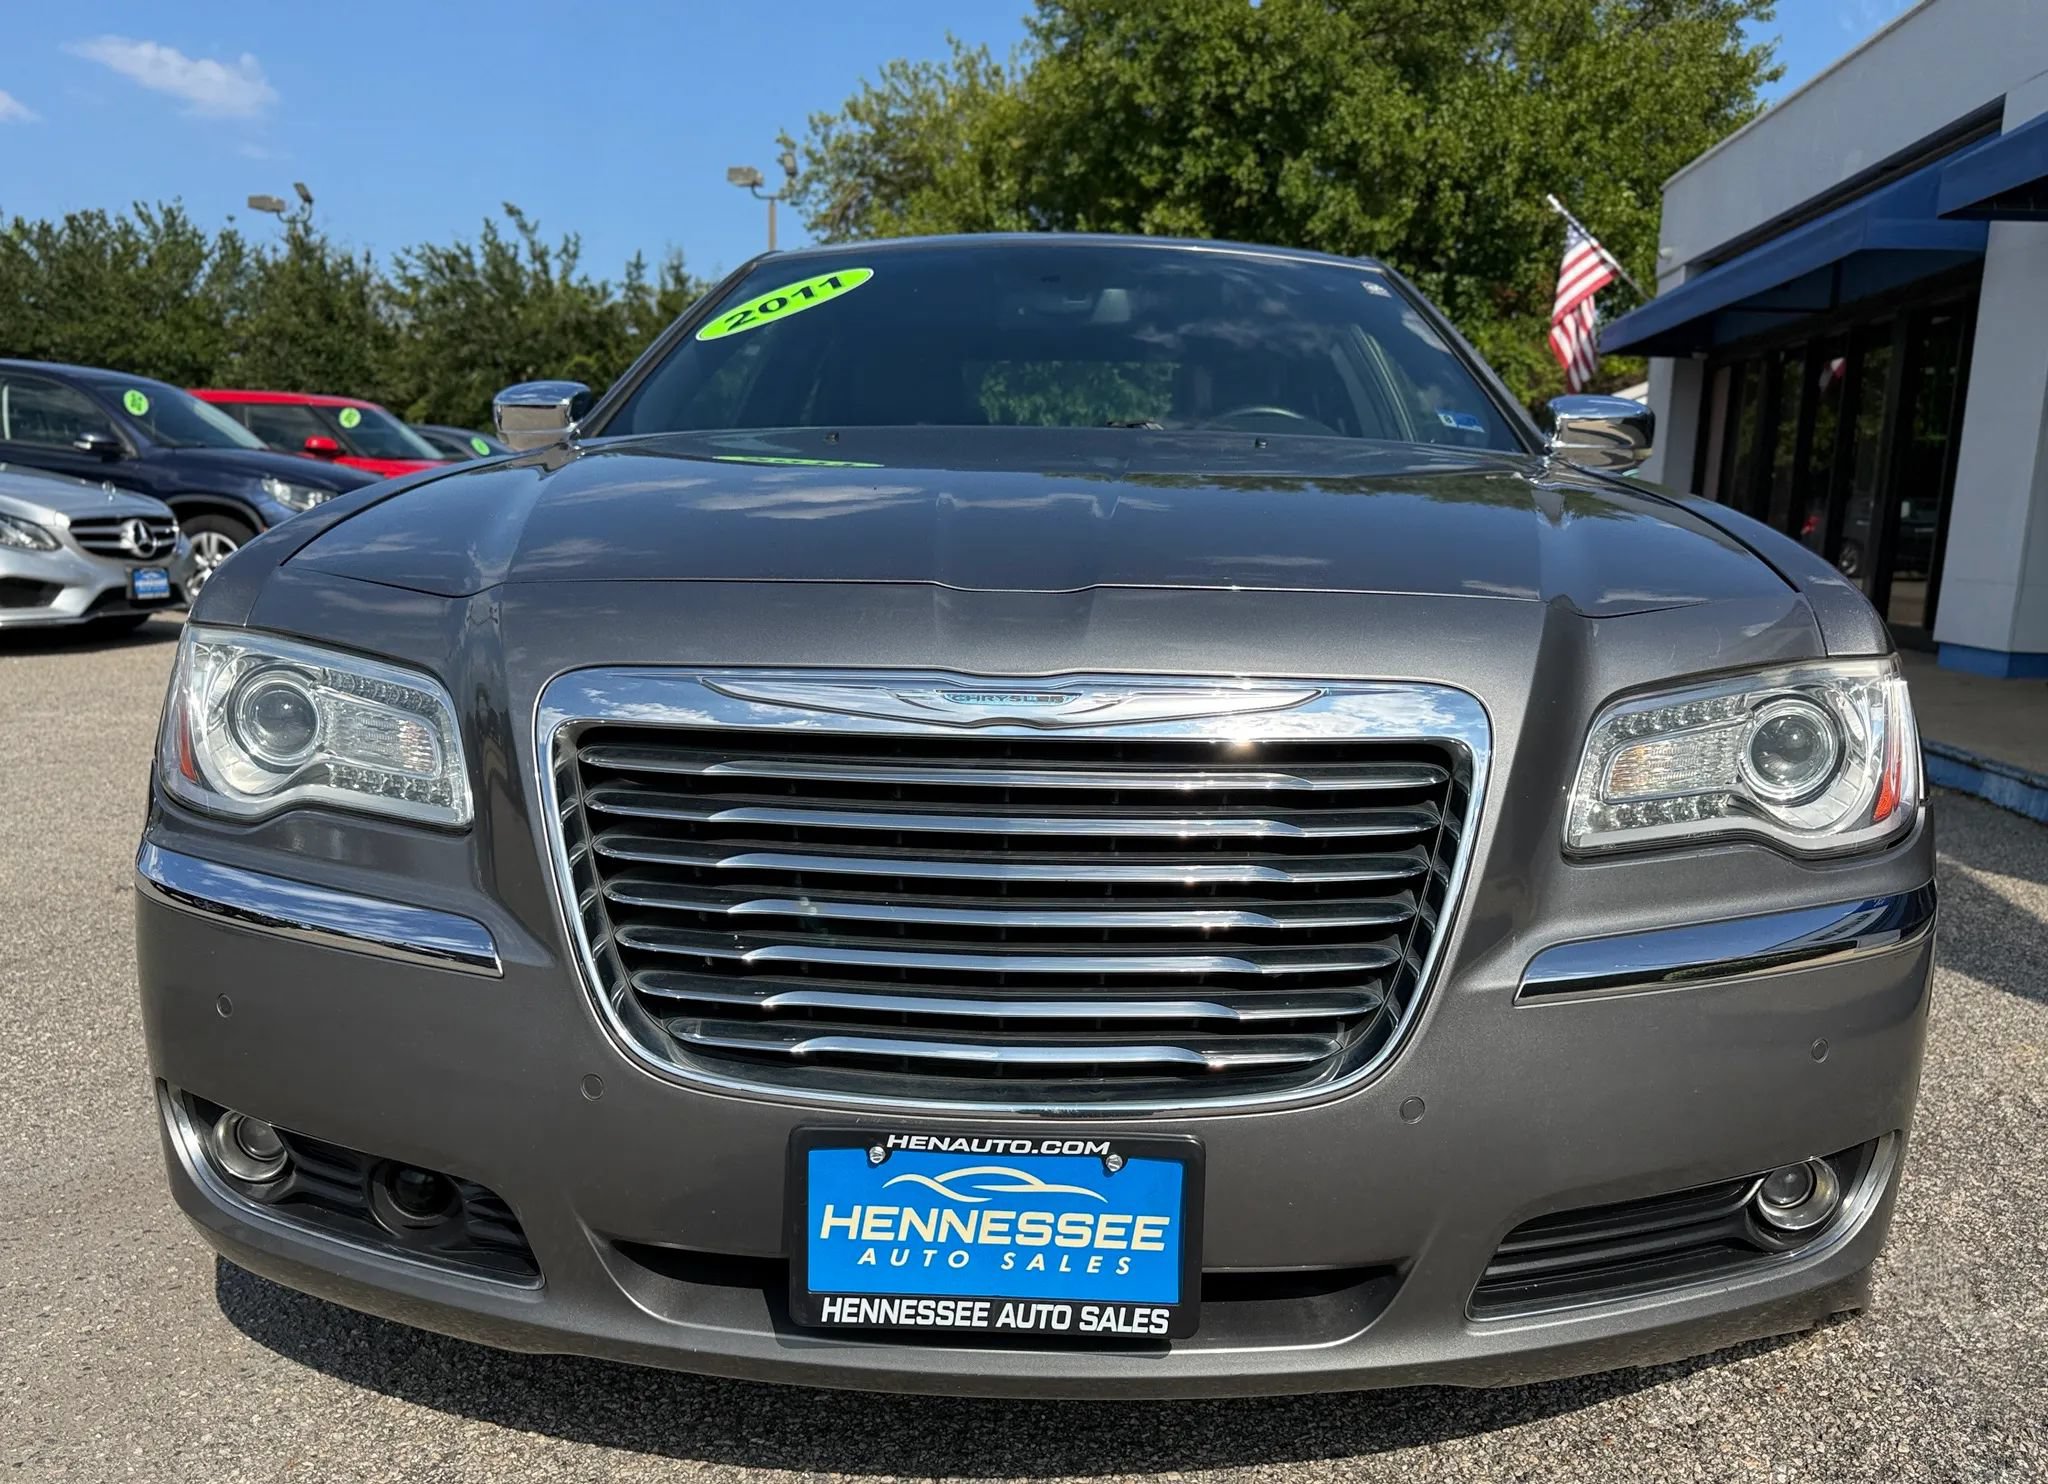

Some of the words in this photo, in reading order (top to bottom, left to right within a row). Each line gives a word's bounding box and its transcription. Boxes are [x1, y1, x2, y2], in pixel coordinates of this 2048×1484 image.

[725, 276, 843, 332] 2011
[951, 693, 1065, 704] CHRYSLER
[886, 1134, 1111, 1156] HENAUTO.COM
[820, 1204, 1170, 1252] HENNESSEE
[858, 1247, 970, 1269] AUTO
[1001, 1252, 1132, 1275] SALES
[821, 1297, 991, 1327] HENNESSEE
[996, 1303, 1073, 1332] AUTO
[1079, 1308, 1170, 1335] SALES
